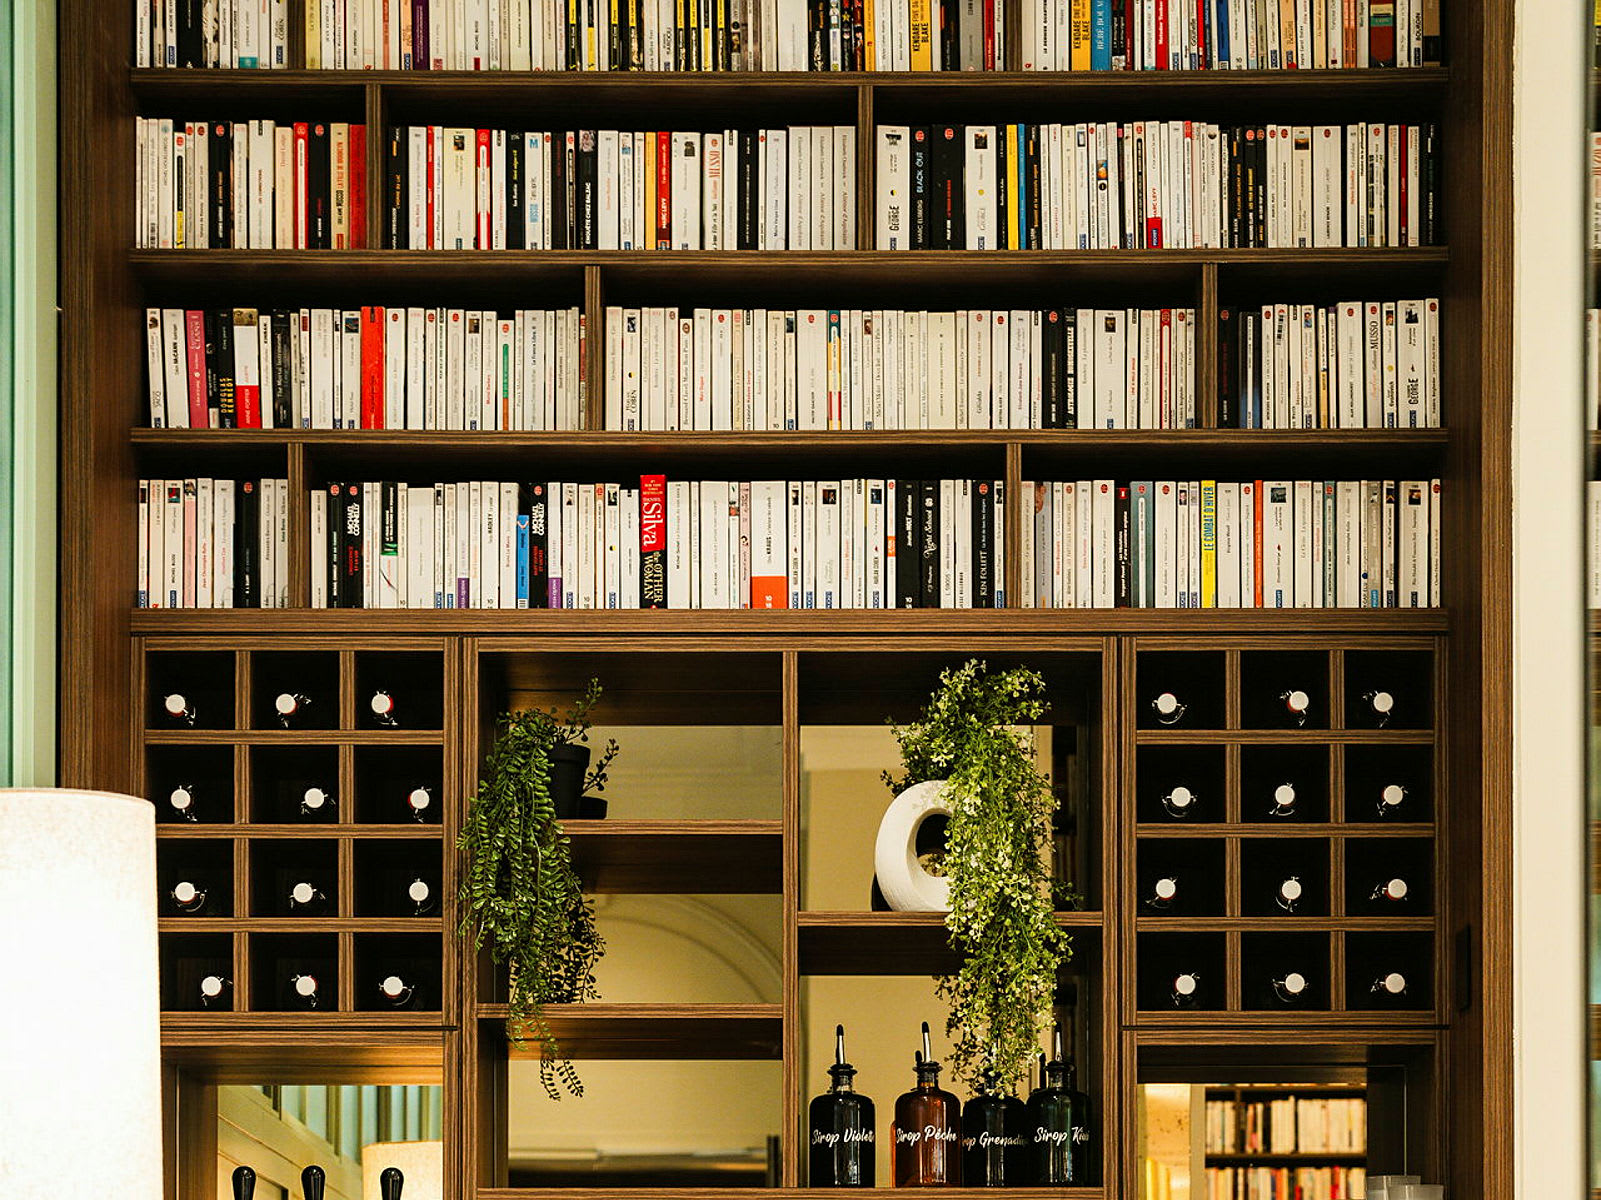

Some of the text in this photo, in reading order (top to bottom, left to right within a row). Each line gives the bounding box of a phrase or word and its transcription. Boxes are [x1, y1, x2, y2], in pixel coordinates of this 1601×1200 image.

[912, 23, 920, 52] KENDARE
[921, 22, 929, 43] BLAKE
[1073, 20, 1081, 49] KENDARE
[1082, 20, 1090, 41] BLAKE
[708, 150, 721, 178] MUSSO
[888, 205, 900, 231] GEORGE
[1370, 320, 1379, 350] MUSSO
[219, 378, 227, 413] DOUGLAS
[226, 377, 234, 413] KENNEDY
[1408, 378, 1419, 405] GEORGE
[531, 504, 539, 534] MICHAEL
[643, 502, 663, 547] Silva
[1203, 486, 1214, 551] LE COMBAT D'HIVER
[923, 510, 937, 559] Night School
[644, 555, 654, 600] WOMAN
[653, 563, 663, 602] OTHER
[980, 550, 988, 596] KEN FOLLETT
[812, 1129, 840, 1148] Sirop
[896, 1128, 920, 1147] Sirop
[1034, 1126, 1068, 1147] Sirop
